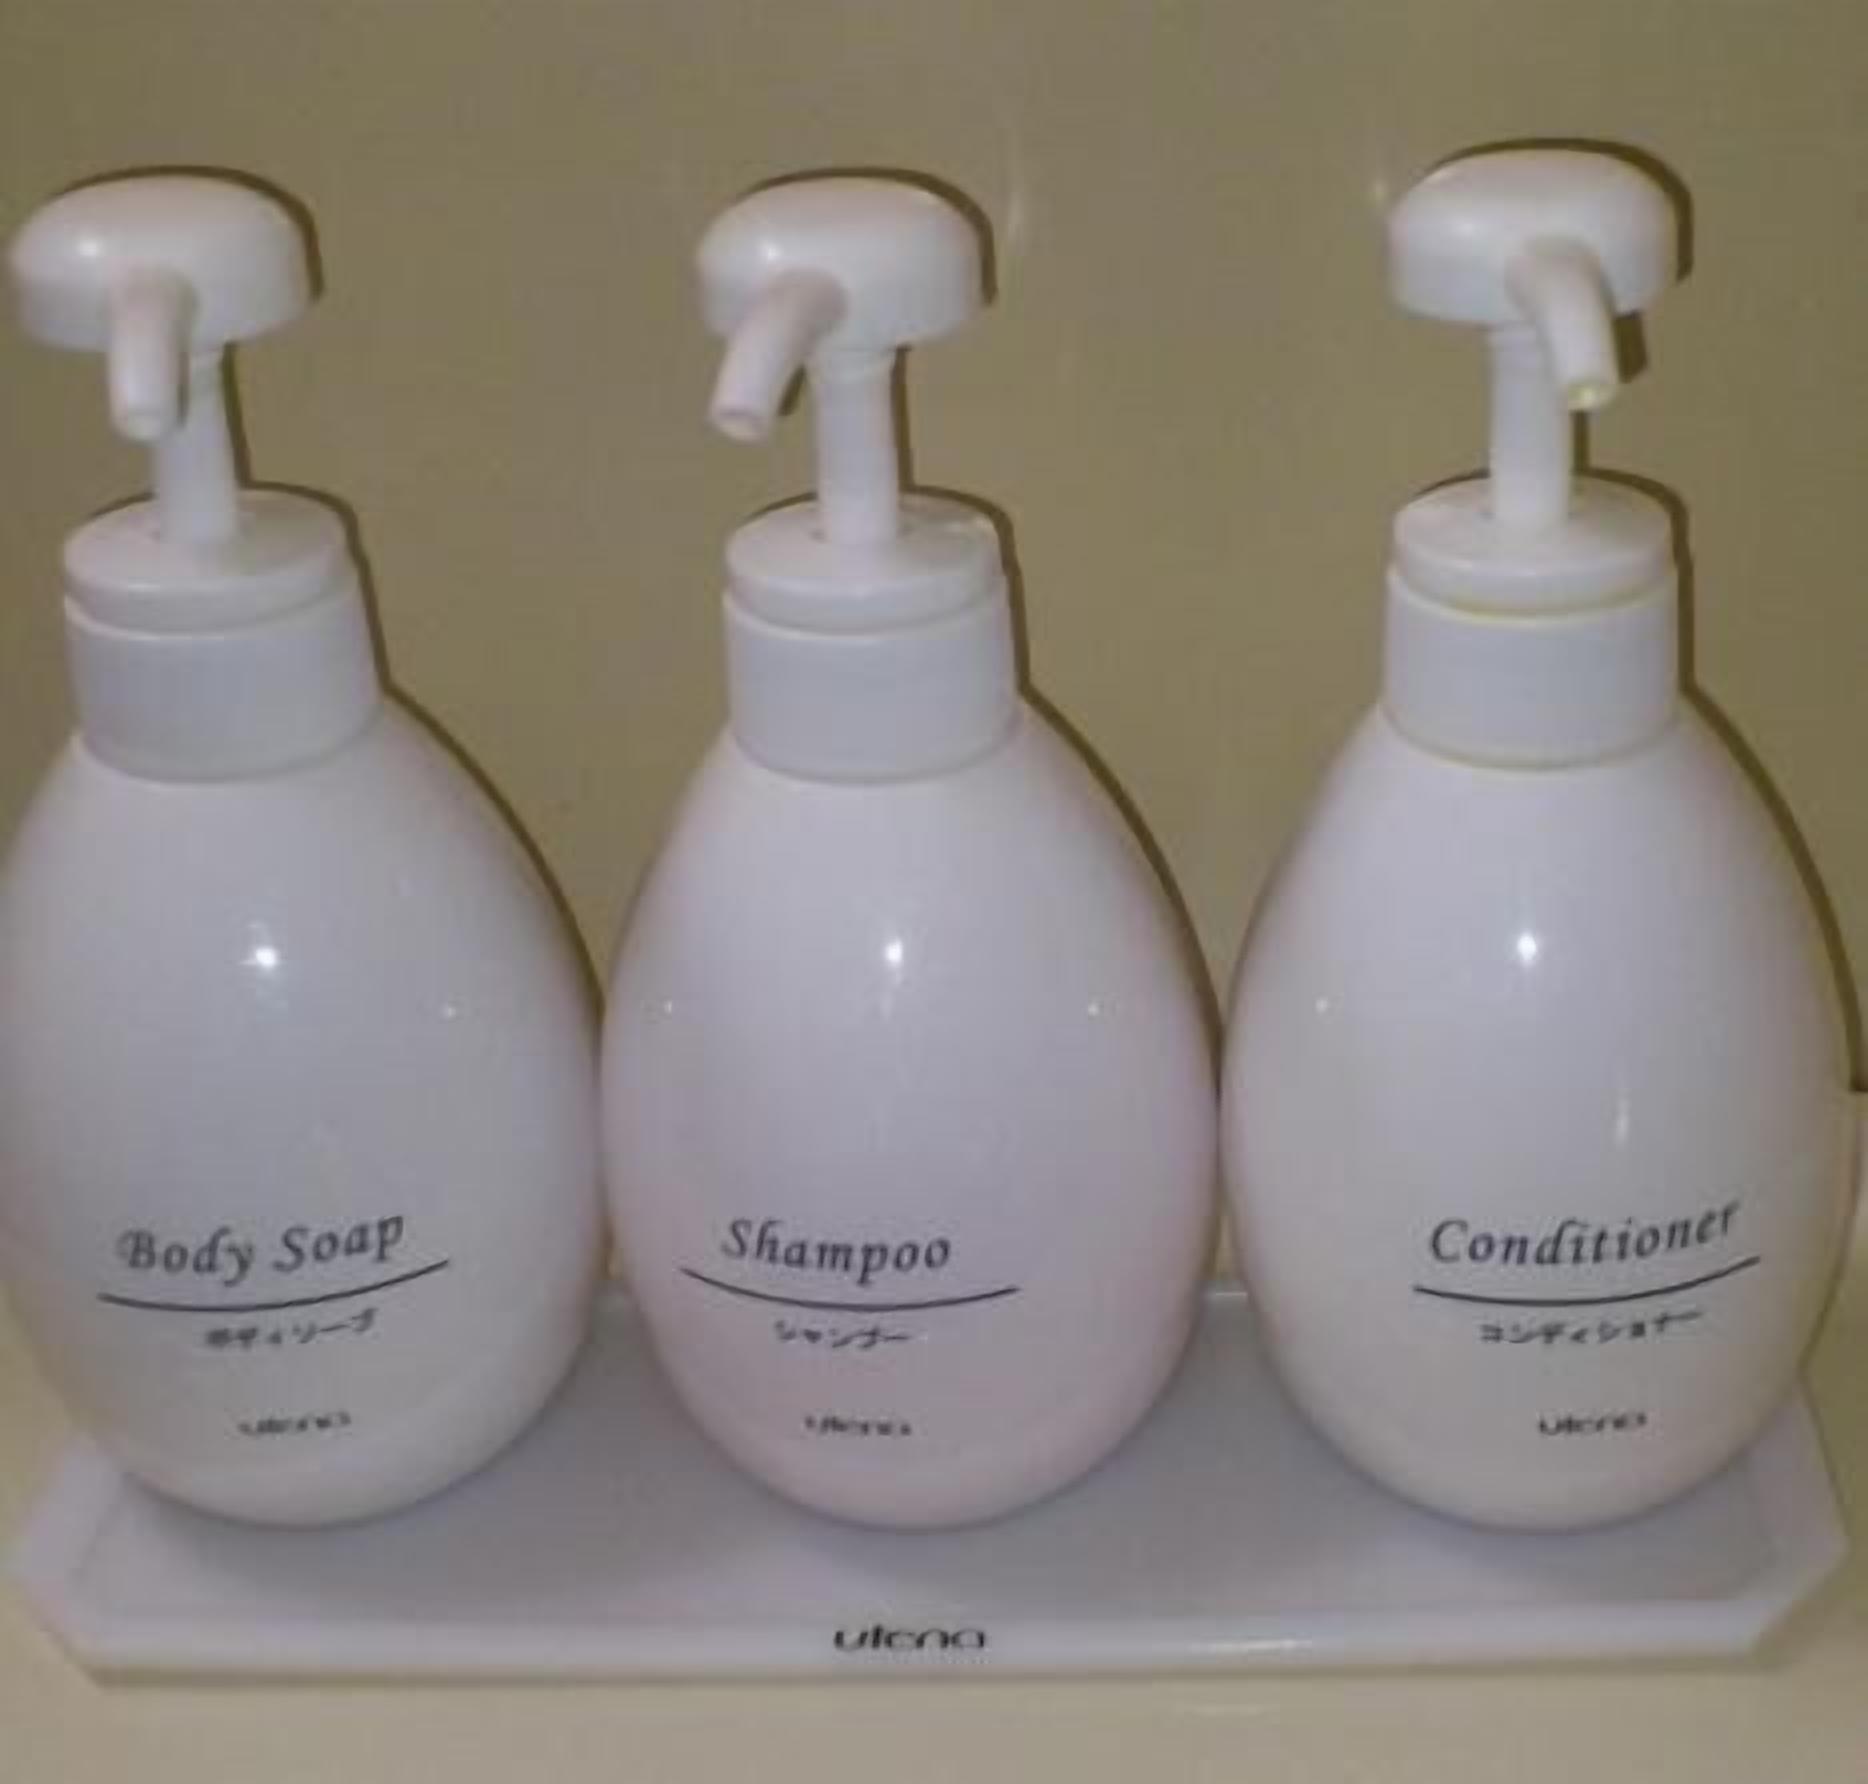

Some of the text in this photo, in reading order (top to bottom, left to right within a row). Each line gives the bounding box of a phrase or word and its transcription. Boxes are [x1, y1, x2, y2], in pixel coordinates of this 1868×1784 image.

[117, 1214, 404, 1287] Body Soap
[721, 1218, 952, 1287] Shampoo
[1429, 1200, 1741, 1266] Conditioner
[833, 1623, 986, 1651] utena
